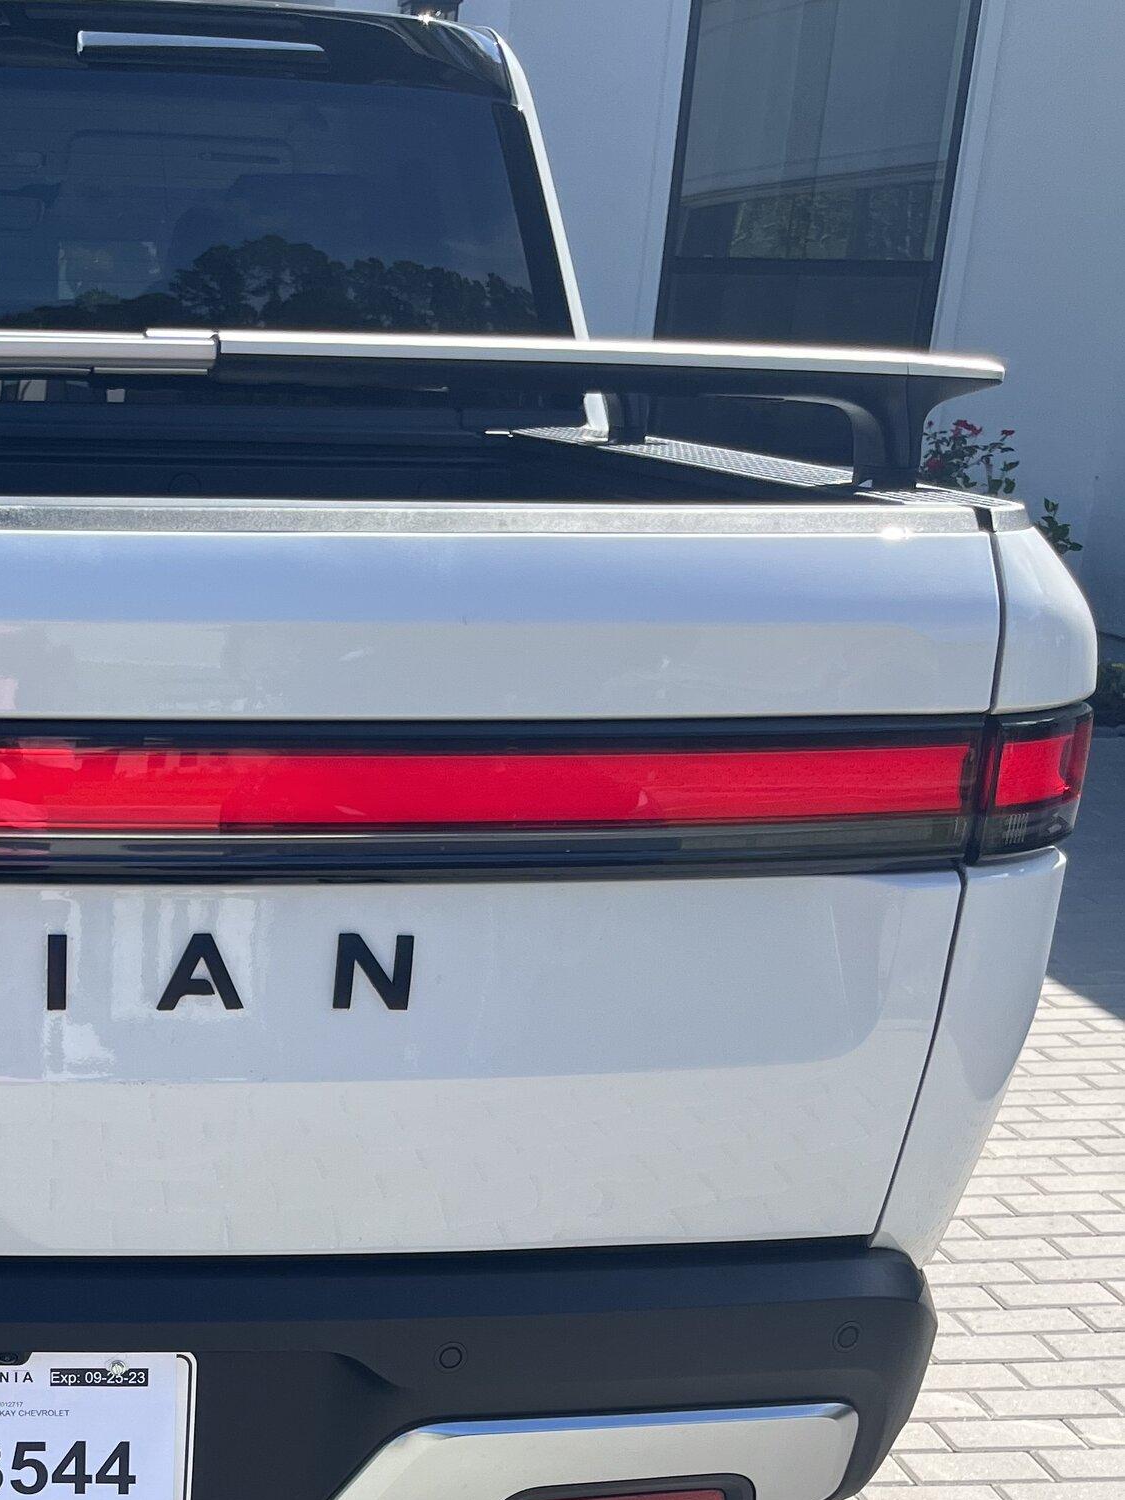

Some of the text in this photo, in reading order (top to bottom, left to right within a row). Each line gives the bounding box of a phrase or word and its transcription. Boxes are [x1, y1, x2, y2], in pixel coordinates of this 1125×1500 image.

[50, 1371, 146, 1386] Exp: 09-25-23
[18, 1409, 70, 1417] CHEVROLET
